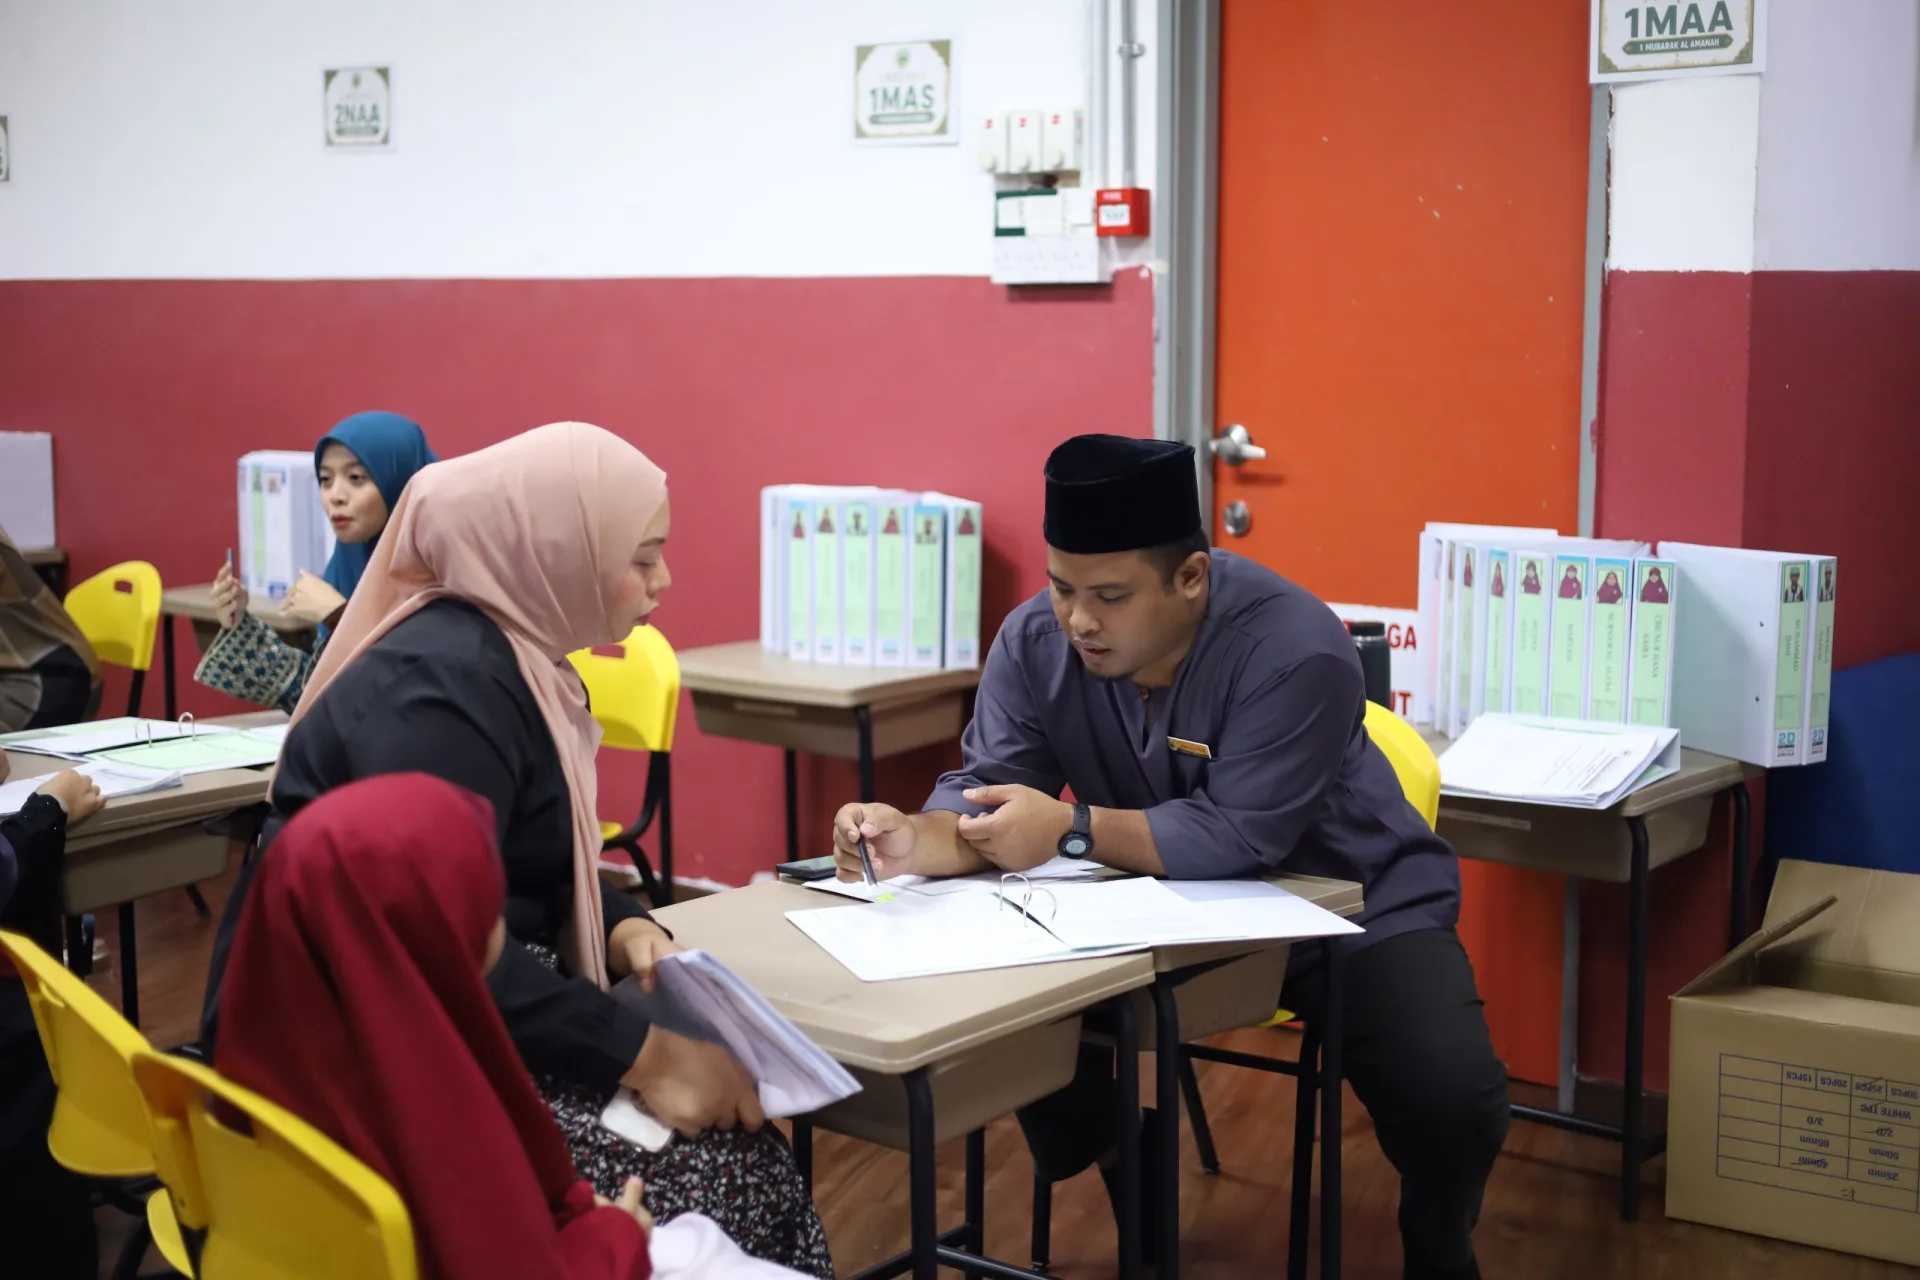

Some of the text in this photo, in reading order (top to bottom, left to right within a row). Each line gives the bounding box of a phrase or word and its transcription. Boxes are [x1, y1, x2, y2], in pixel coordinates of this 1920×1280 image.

[1624, 0, 1734, 38] 1MAA
[1645, 39, 1680, 51] MUBARAK
[1680, 40, 1689, 49] AL
[1689, 38, 1720, 49] AMANAH
[870, 84, 934, 111] 1MAS
[1786, 1071, 1812, 1082] 15PCS
[1820, 1076, 1848, 1088] 20PCS
[1881, 1107, 1911, 1119] WHITE
[1807, 1116, 1824, 1126] 3/D
[1869, 1147, 1900, 1160] 50mm
[1868, 1169, 1899, 1181] 25mm
